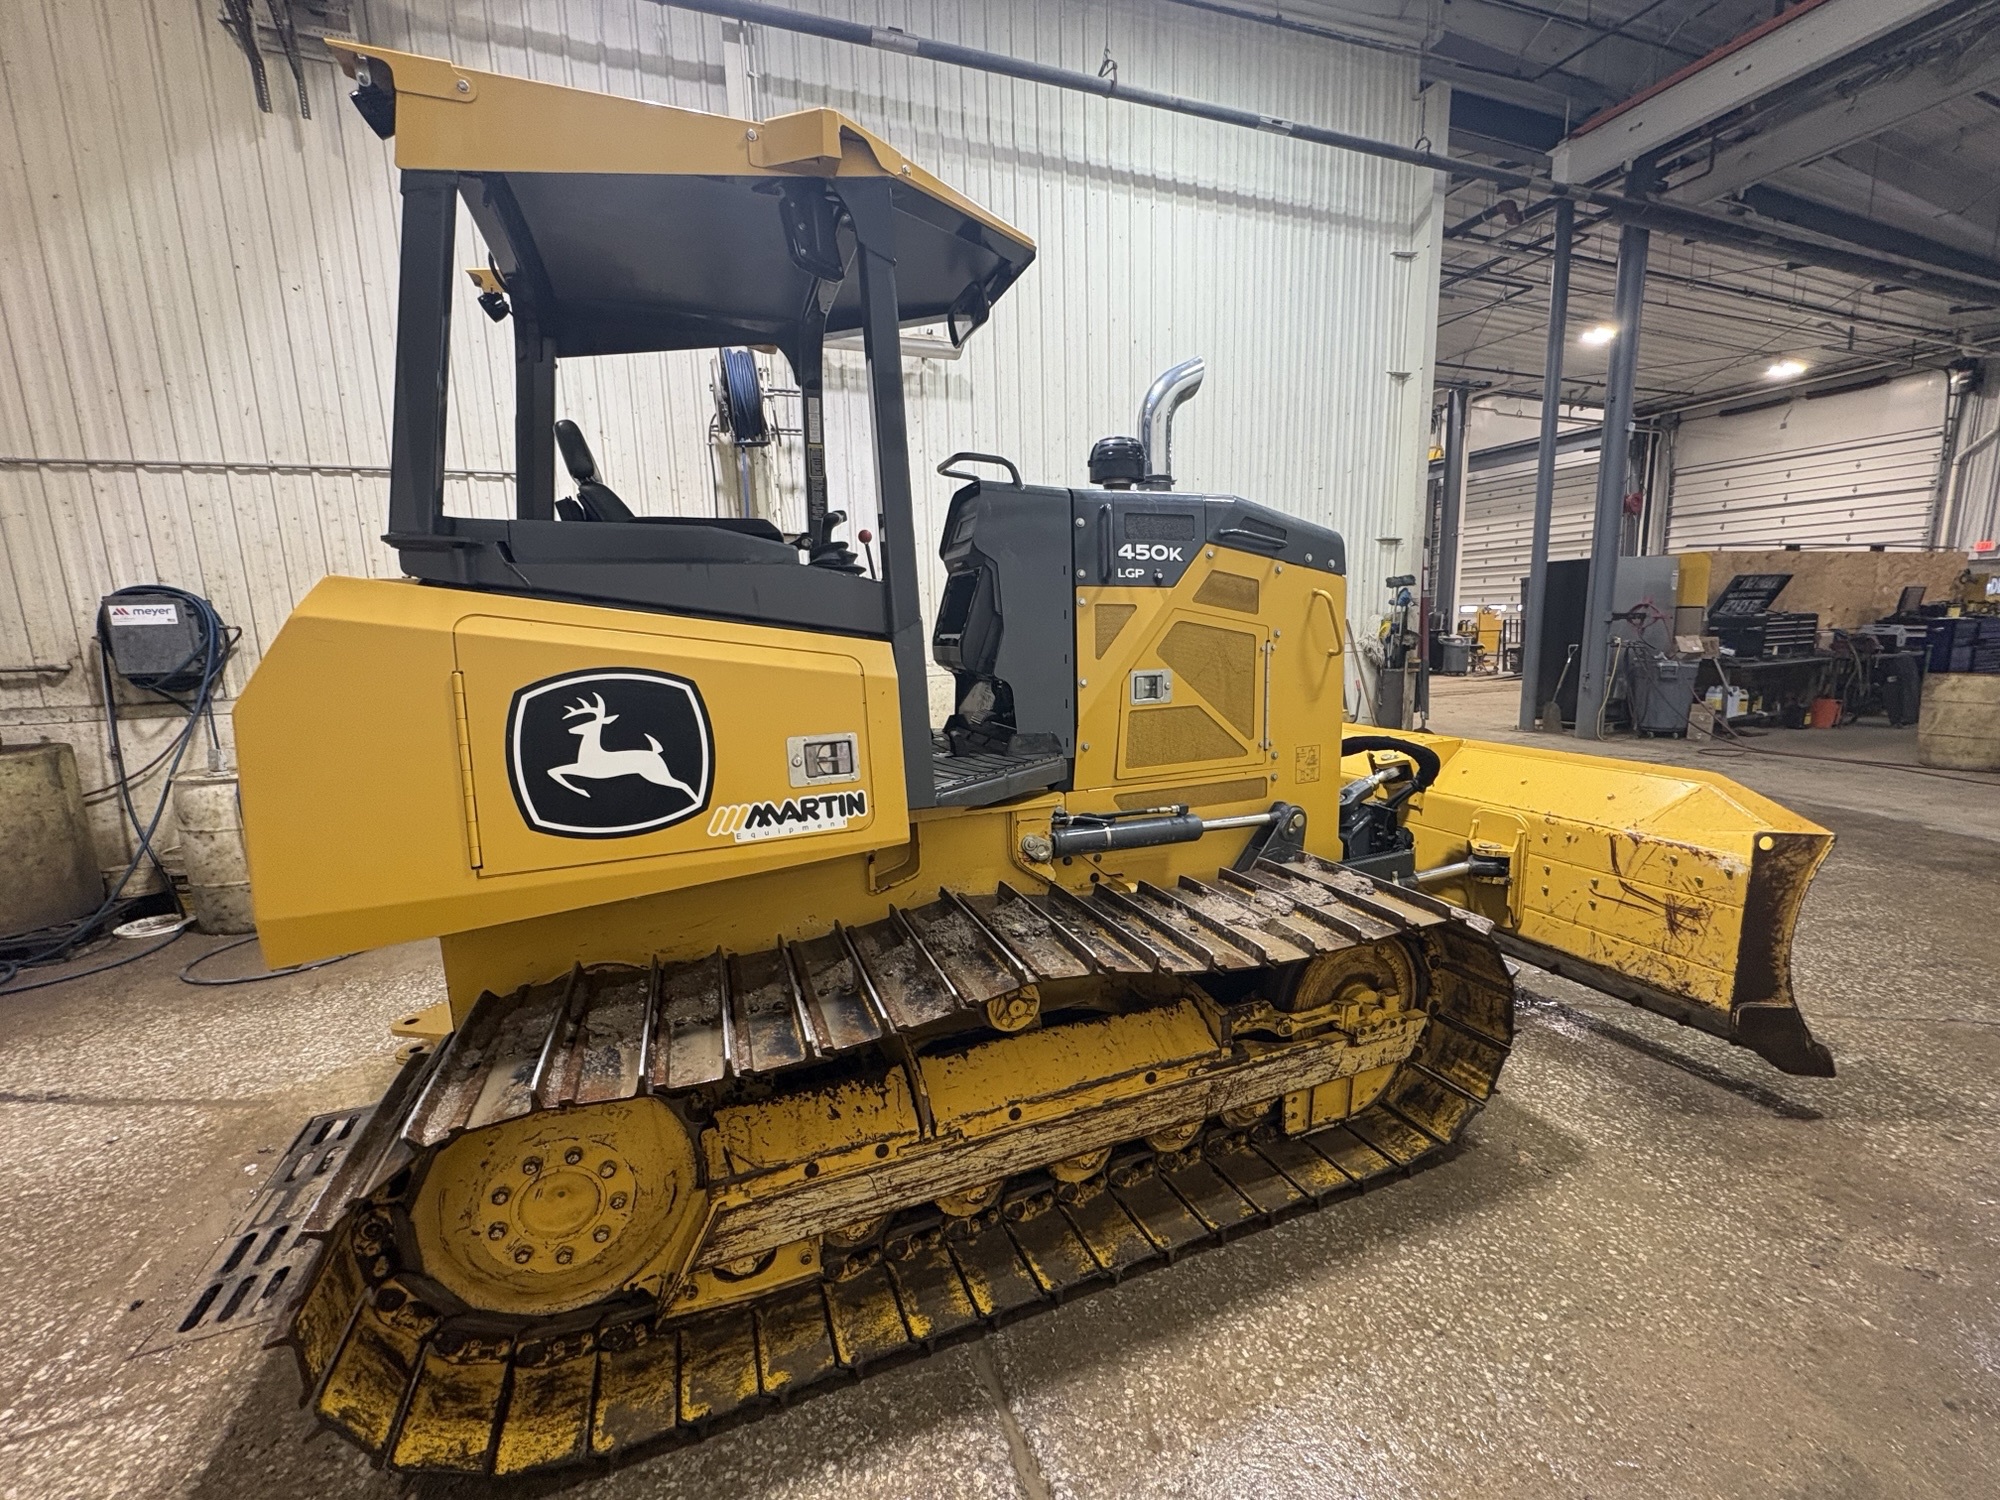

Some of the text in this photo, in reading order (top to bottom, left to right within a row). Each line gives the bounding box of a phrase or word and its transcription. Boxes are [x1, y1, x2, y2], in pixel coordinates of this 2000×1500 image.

[1118, 543, 1183, 561] 450K
[1117, 568, 1145, 578] LGP
[133, 608, 171, 616] meyer
[744, 791, 866, 830] MARTIN
[736, 819, 847, 840] Equipment
